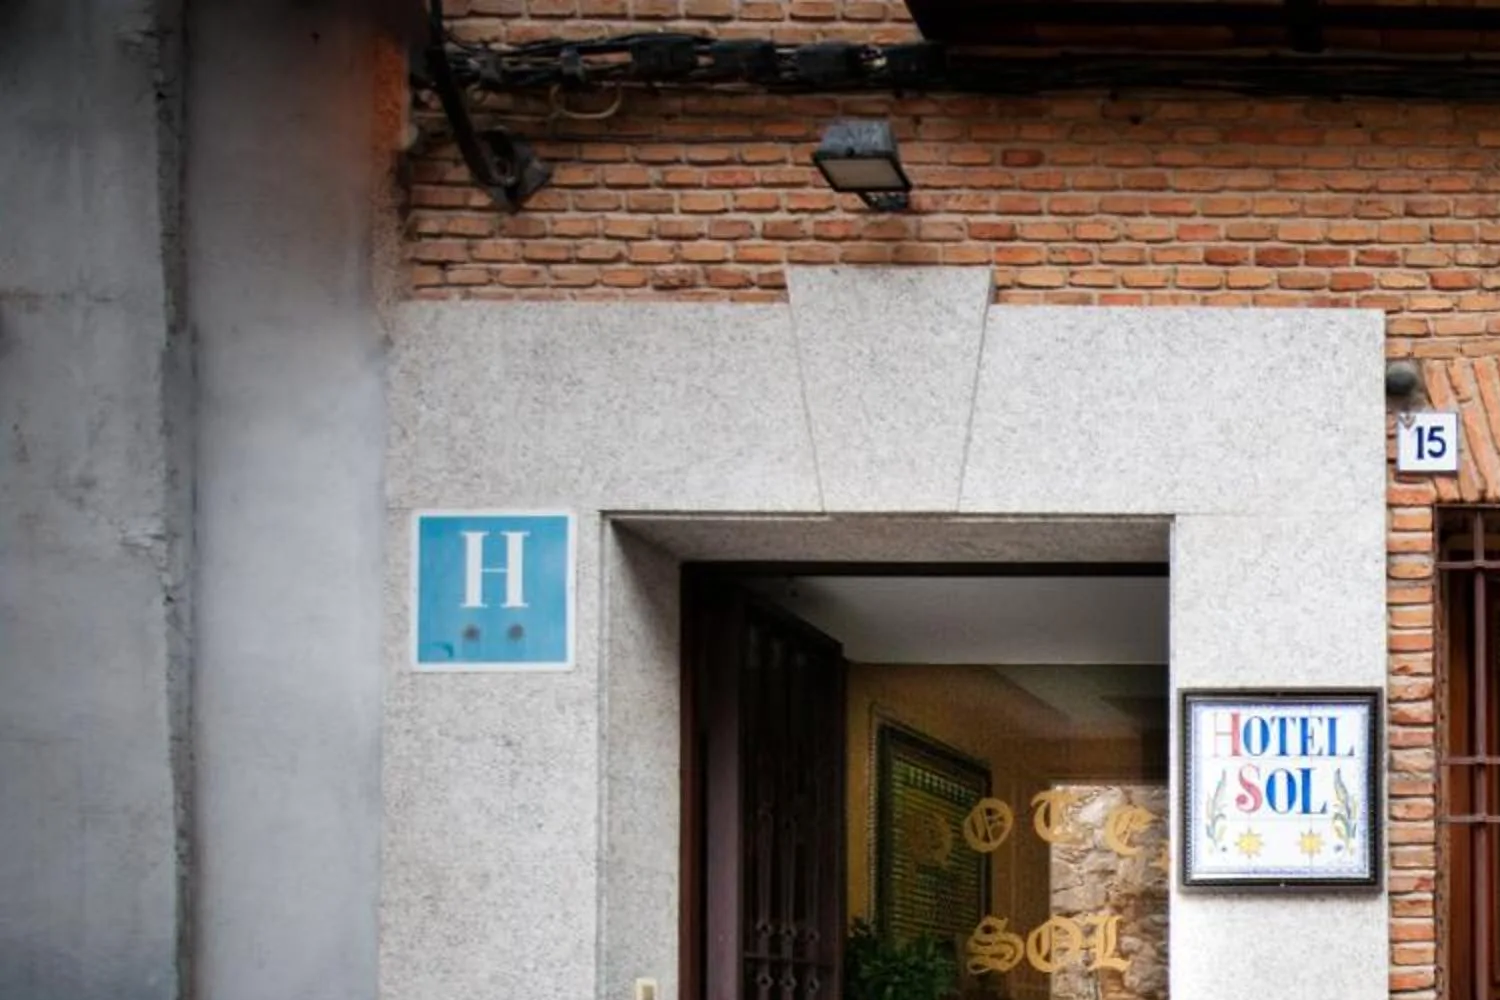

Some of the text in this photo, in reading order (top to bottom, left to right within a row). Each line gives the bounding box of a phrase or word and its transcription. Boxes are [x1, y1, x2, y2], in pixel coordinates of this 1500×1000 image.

[1415, 425, 1447, 460] 15
[460, 530, 531, 608] H
[1212, 711, 1355, 757] HOTEL
[1235, 763, 1328, 815] SOL
[906, 788, 1170, 872] OTE
[966, 913, 1132, 975] SOL
